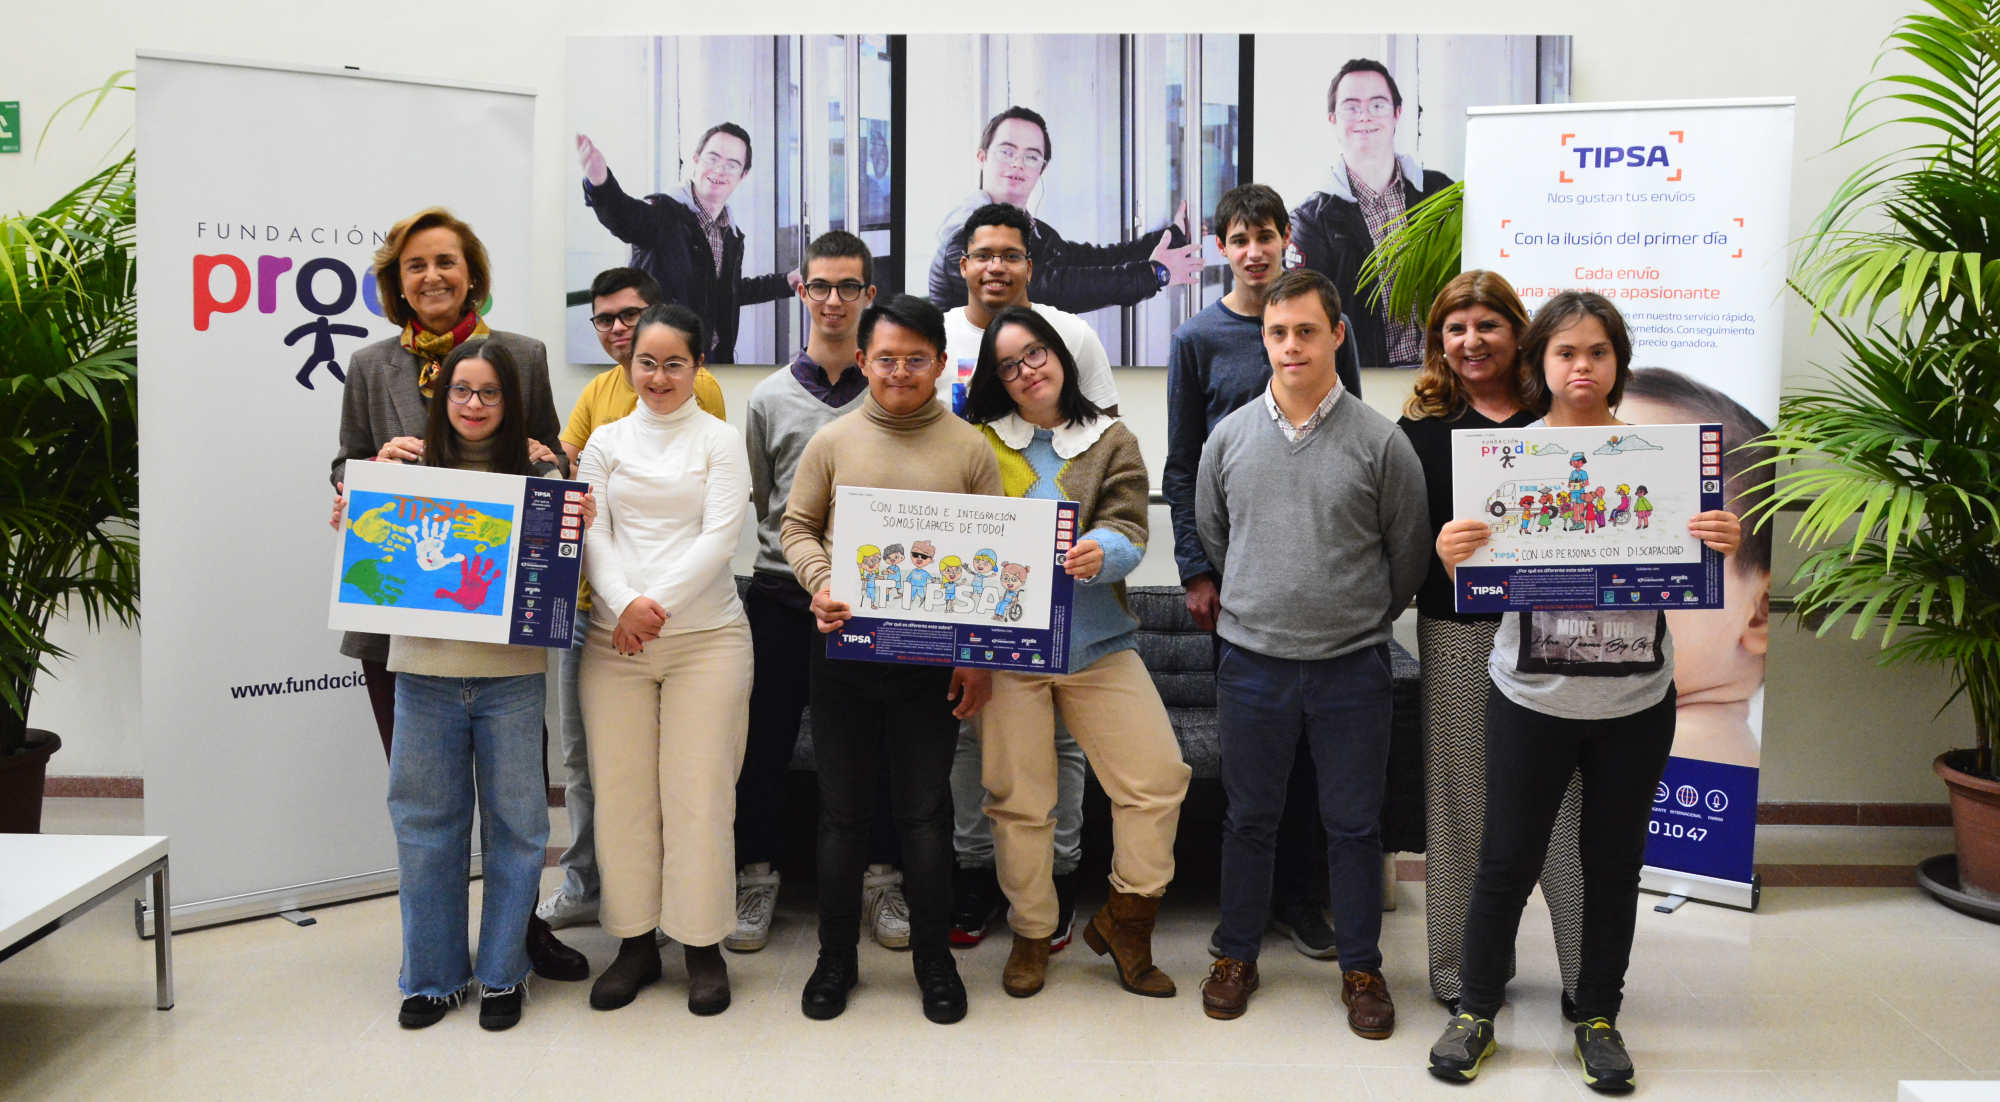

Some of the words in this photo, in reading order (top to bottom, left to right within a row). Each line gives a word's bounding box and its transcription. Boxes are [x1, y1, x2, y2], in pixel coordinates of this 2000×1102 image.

[1572, 145, 1670, 168] TIPSA
[1547, 192, 1573, 203] Nos
[1576, 193, 1623, 205] gustan
[1626, 192, 1648, 202] tus
[1651, 191, 1696, 202] envíos
[198, 221, 387, 246] FUNDACIÓN
[1514, 232, 1543, 245] Con
[1547, 232, 1560, 245] la
[1564, 232, 1613, 245] ilusión
[1616, 231, 1640, 245] del
[1644, 232, 1699, 247] primer
[1703, 231, 1728, 245] día
[1575, 267, 1613, 280] Cada
[1617, 266, 1660, 280] envío
[1516, 287, 1544, 297] una
[1620, 286, 1720, 300] apasionante
[1646, 313, 1682, 321] nuestro
[1684, 312, 1720, 321] servicio
[1722, 313, 1756, 323] rápido,
[1677, 325, 1695, 334] Con
[1696, 326, 1755, 336] seguimiento
[1670, 339, 1718, 349] ganadora.
[1481, 441, 1539, 457] prodis
[393, 495, 476, 522] TIPSA
[870, 501, 891, 513] CON
[898, 504, 938, 516] ILUSIÓN
[944, 508, 949, 517] E
[957, 509, 1016, 521] INTEGRACIÓN
[883, 516, 914, 529] SOMOS
[960, 523, 972, 533] DE
[976, 523, 1005, 536] TODO!
[1522, 549, 1538, 560] CON
[1541, 549, 1553, 559] LAS
[1556, 549, 1597, 558] PERSONAS
[1600, 547, 1620, 557] CON
[1627, 546, 1684, 557] DISCAPACIDAD
[875, 579, 1000, 614] TIPSA
[1471, 586, 1504, 595] TIPSA
[1557, 619, 1595, 637] MOVE
[1602, 621, 1634, 638] OVER
[842, 634, 871, 644] TIPSA
[1605, 638, 1629, 654] Big
[1631, 637, 1652, 654] City
[1670, 810, 1702, 819] INTERNACIONAL
[1663, 822, 1683, 838] 10
[1687, 827, 1707, 841] 47
